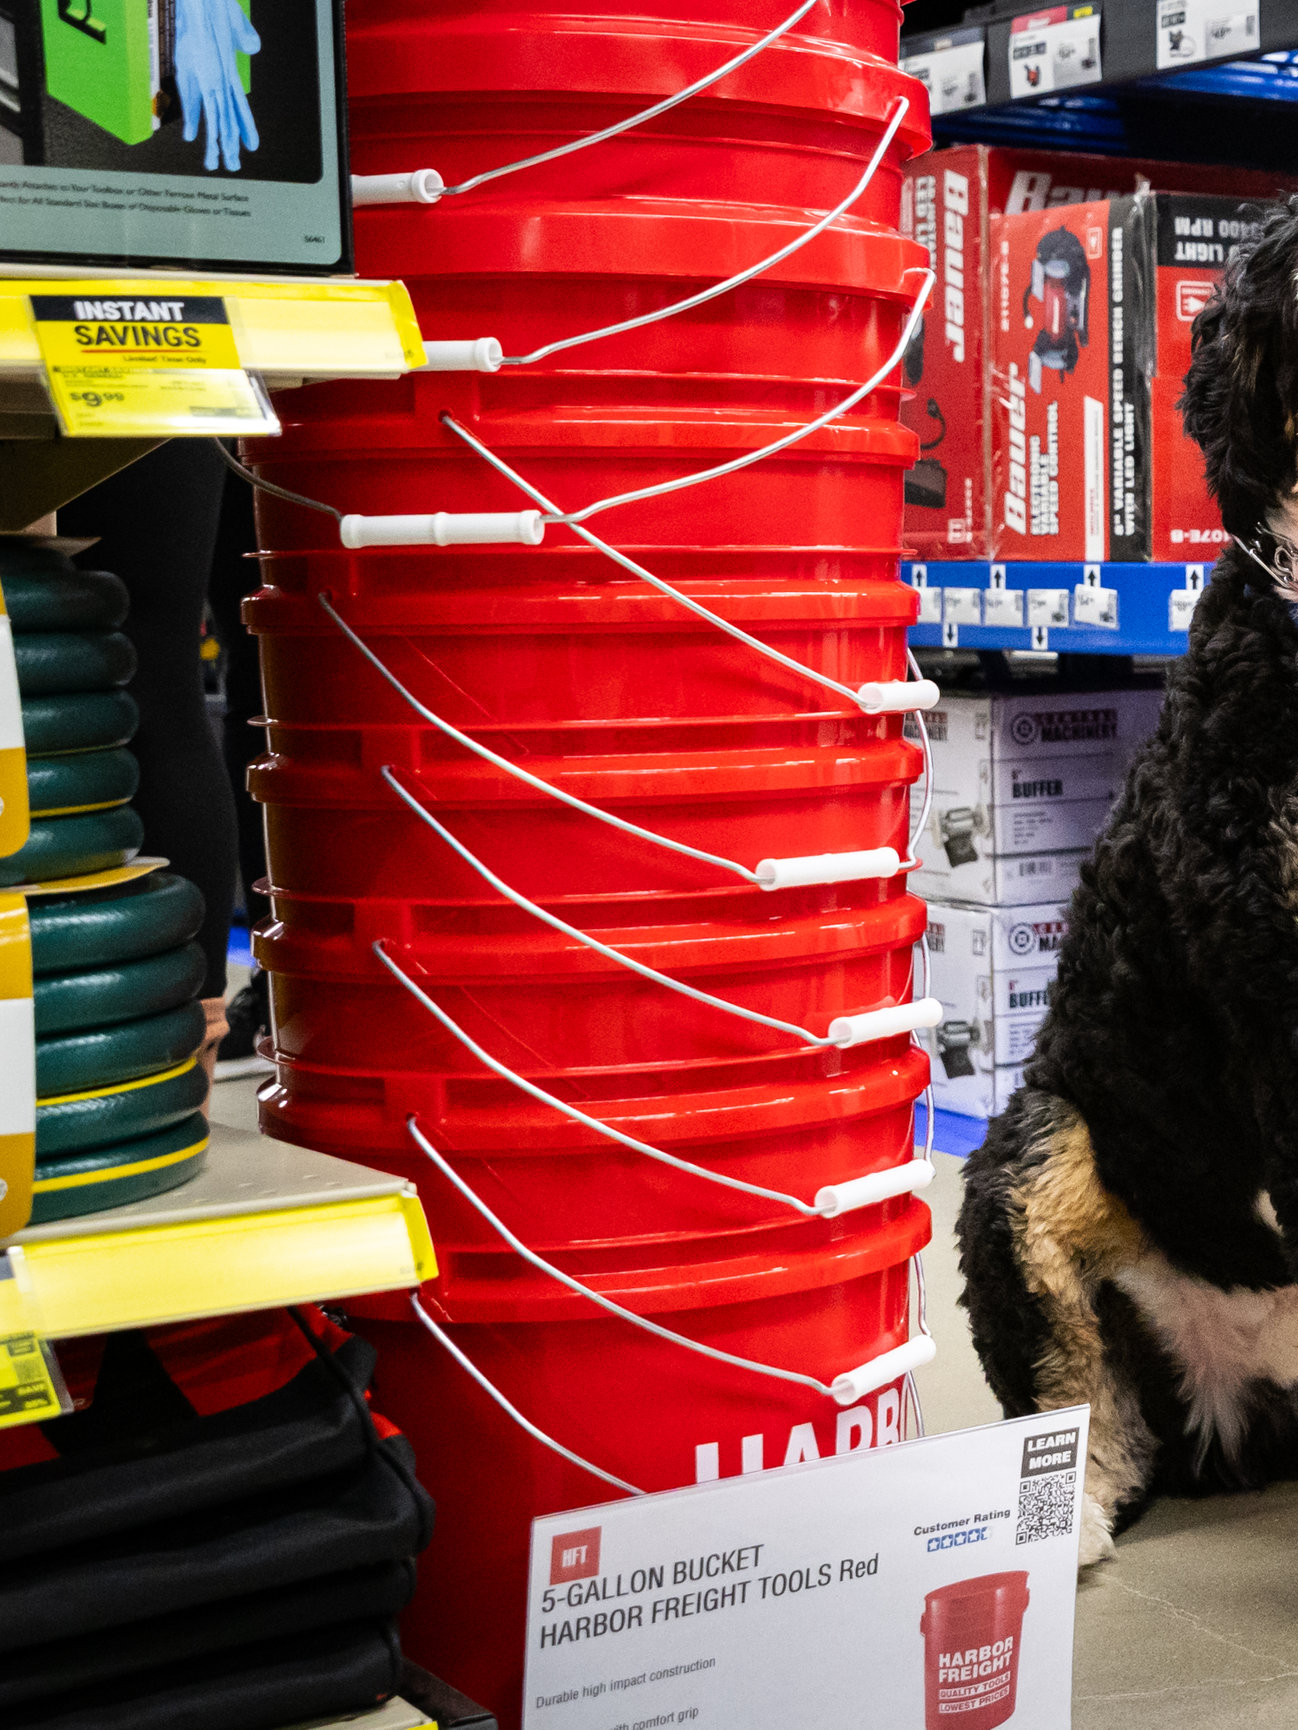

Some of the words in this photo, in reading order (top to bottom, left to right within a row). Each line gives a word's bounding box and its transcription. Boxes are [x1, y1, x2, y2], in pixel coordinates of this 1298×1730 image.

[46, 199, 82, 208] Standard
[139, 203, 182, 214] Disposable
[197, 191, 219, 200] Metal
[1174, 216, 1214, 238] RPM
[944, 169, 969, 363] Bauer
[1111, 227, 1124, 303] GRINDER
[1174, 242, 1225, 262] LIGHT
[73, 300, 184, 322] INSTANT
[74, 325, 202, 347] SAVINGS
[1112, 307, 1124, 364] BENCH
[1112, 368, 1124, 424] SPEED
[1047, 401, 1059, 477] CONTROL
[1124, 402, 1136, 450] LIGHT
[1004, 362, 1027, 536] Bauer
[1029, 434, 1041, 536] ELECTRONIC
[1112, 427, 1124, 511] VARIABLE
[1124, 455, 1136, 488] LED
[1039, 453, 1050, 536] VARIABLE
[1048, 479, 1059, 536] SPEED
[1124, 499, 1136, 536] WITH
[1012, 779, 1063, 798] BUFFER
[1027, 1431, 1076, 1452] LEARN
[1029, 1451, 1072, 1470] MORE
[913, 1517, 970, 1536] Customer
[973, 1508, 1011, 1525] Rating
[562, 1545, 588, 1568] HFT
[541, 1565, 664, 1613] 5-GALLON
[672, 1544, 765, 1585] BUCKET
[540, 1605, 643, 1649] HARBOR
[651, 1581, 752, 1624] FREIGHT
[758, 1562, 832, 1599] TOOLS
[839, 1553, 879, 1581] Red
[938, 1636, 1014, 1668] HARBOR
[938, 1652, 1013, 1685] FREIGHT
[536, 1689, 580, 1709] Durable
[582, 1683, 607, 1699] high
[610, 1672, 647, 1692] impact
[650, 1657, 716, 1682] construction
[940, 1681, 982, 1699] QUALITY
[982, 1671, 1011, 1690] TOOLS
[940, 1695, 976, 1714] LOWEST
[978, 1685, 1010, 1706] PRICES
[633, 1713, 676, 1730] comfort
[677, 1706, 700, 1725] grip
